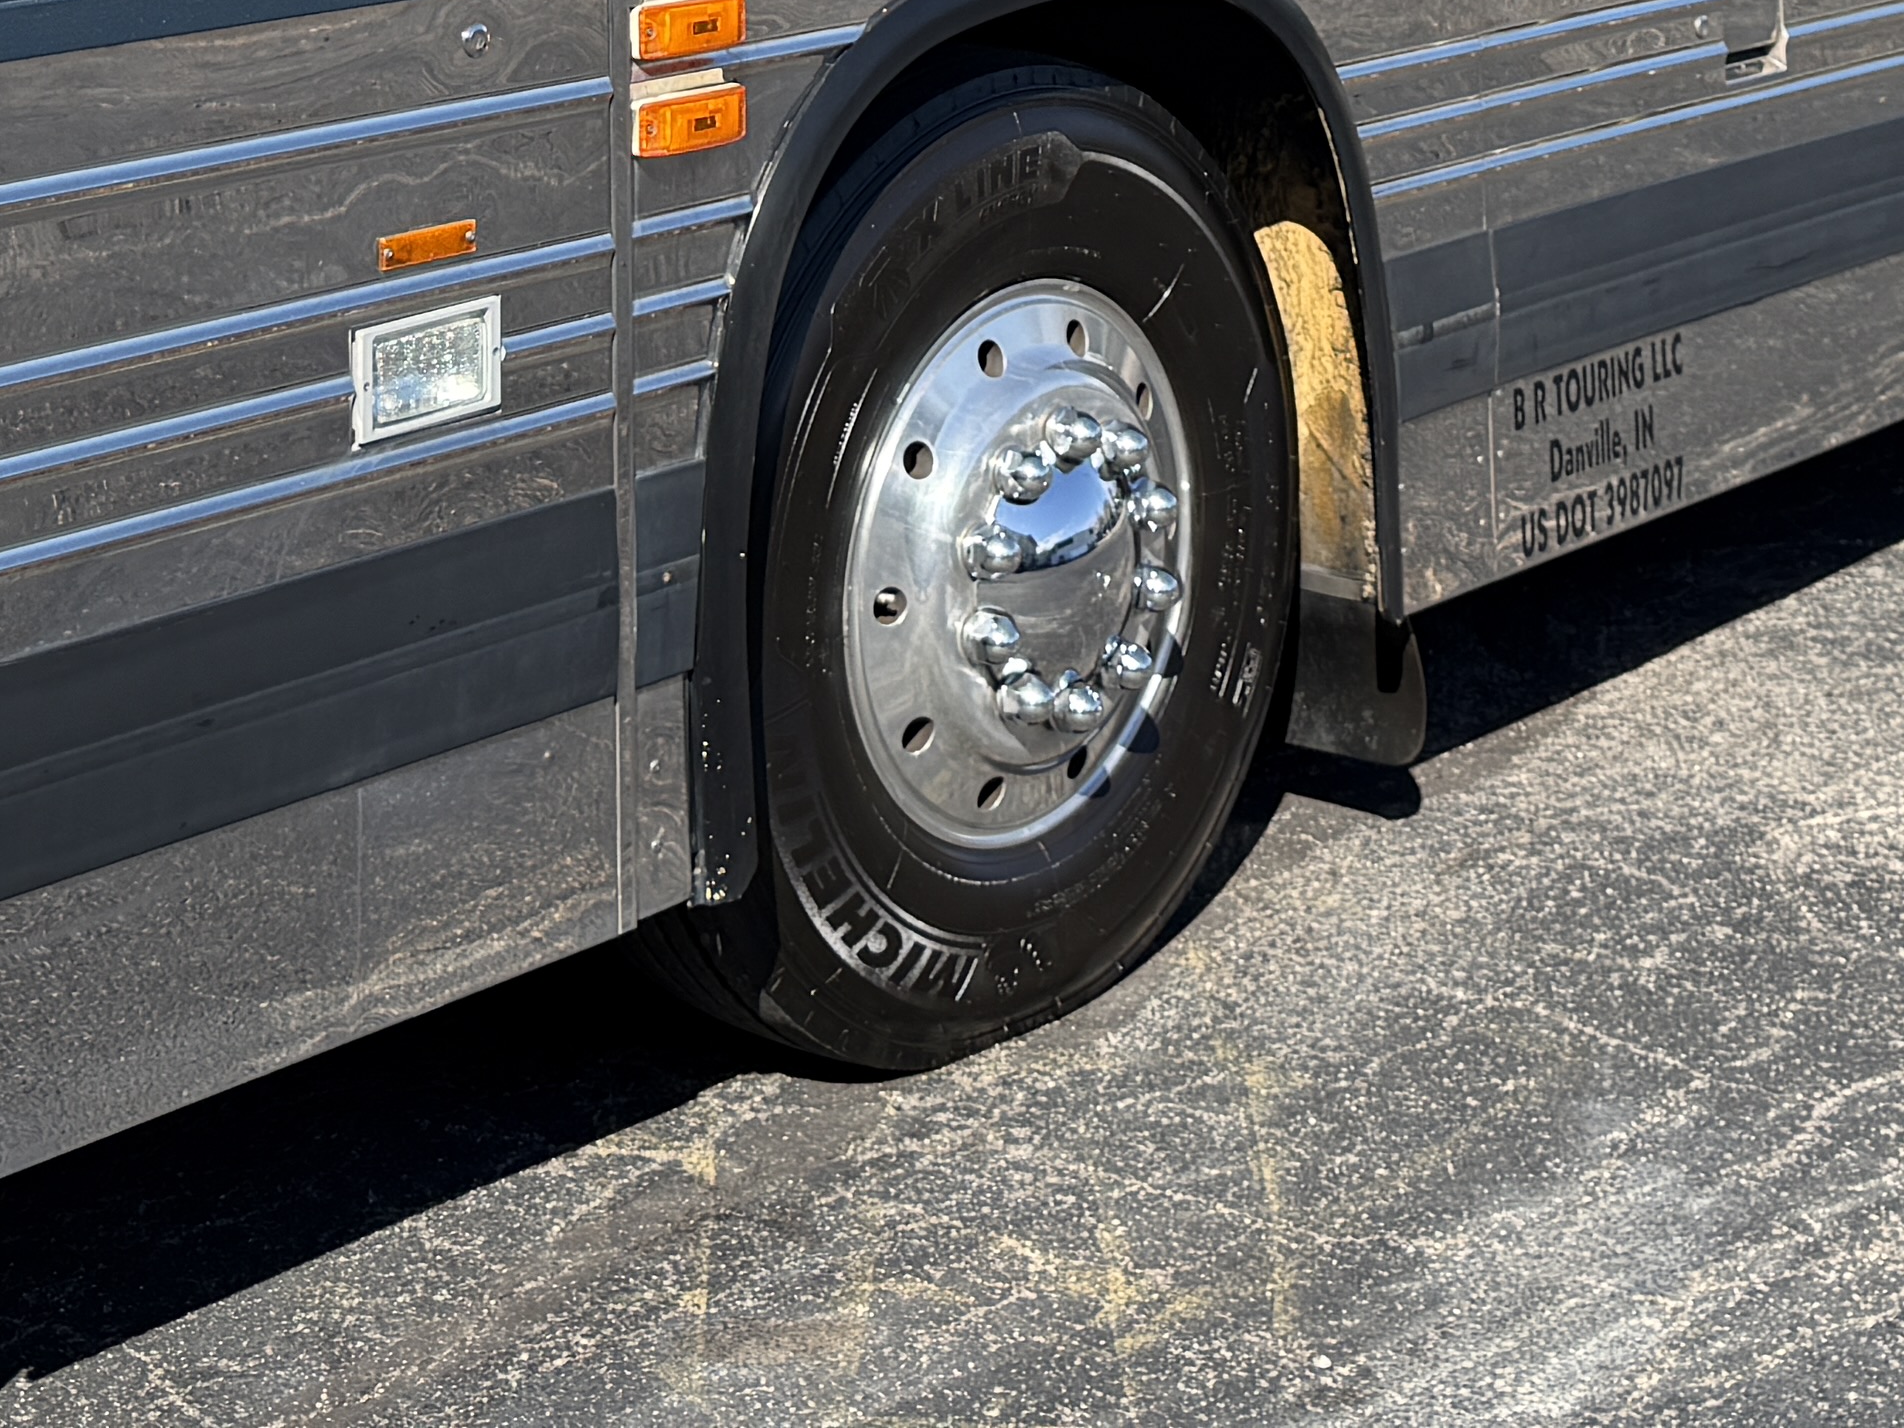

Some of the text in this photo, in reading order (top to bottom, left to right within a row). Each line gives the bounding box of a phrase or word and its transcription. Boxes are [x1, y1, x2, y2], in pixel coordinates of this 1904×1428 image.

[1512, 332, 1683, 431] B R TOURING LLC
[1549, 404, 1656, 482] Danville, IN
[1520, 455, 1685, 558] US DOT 3987097
